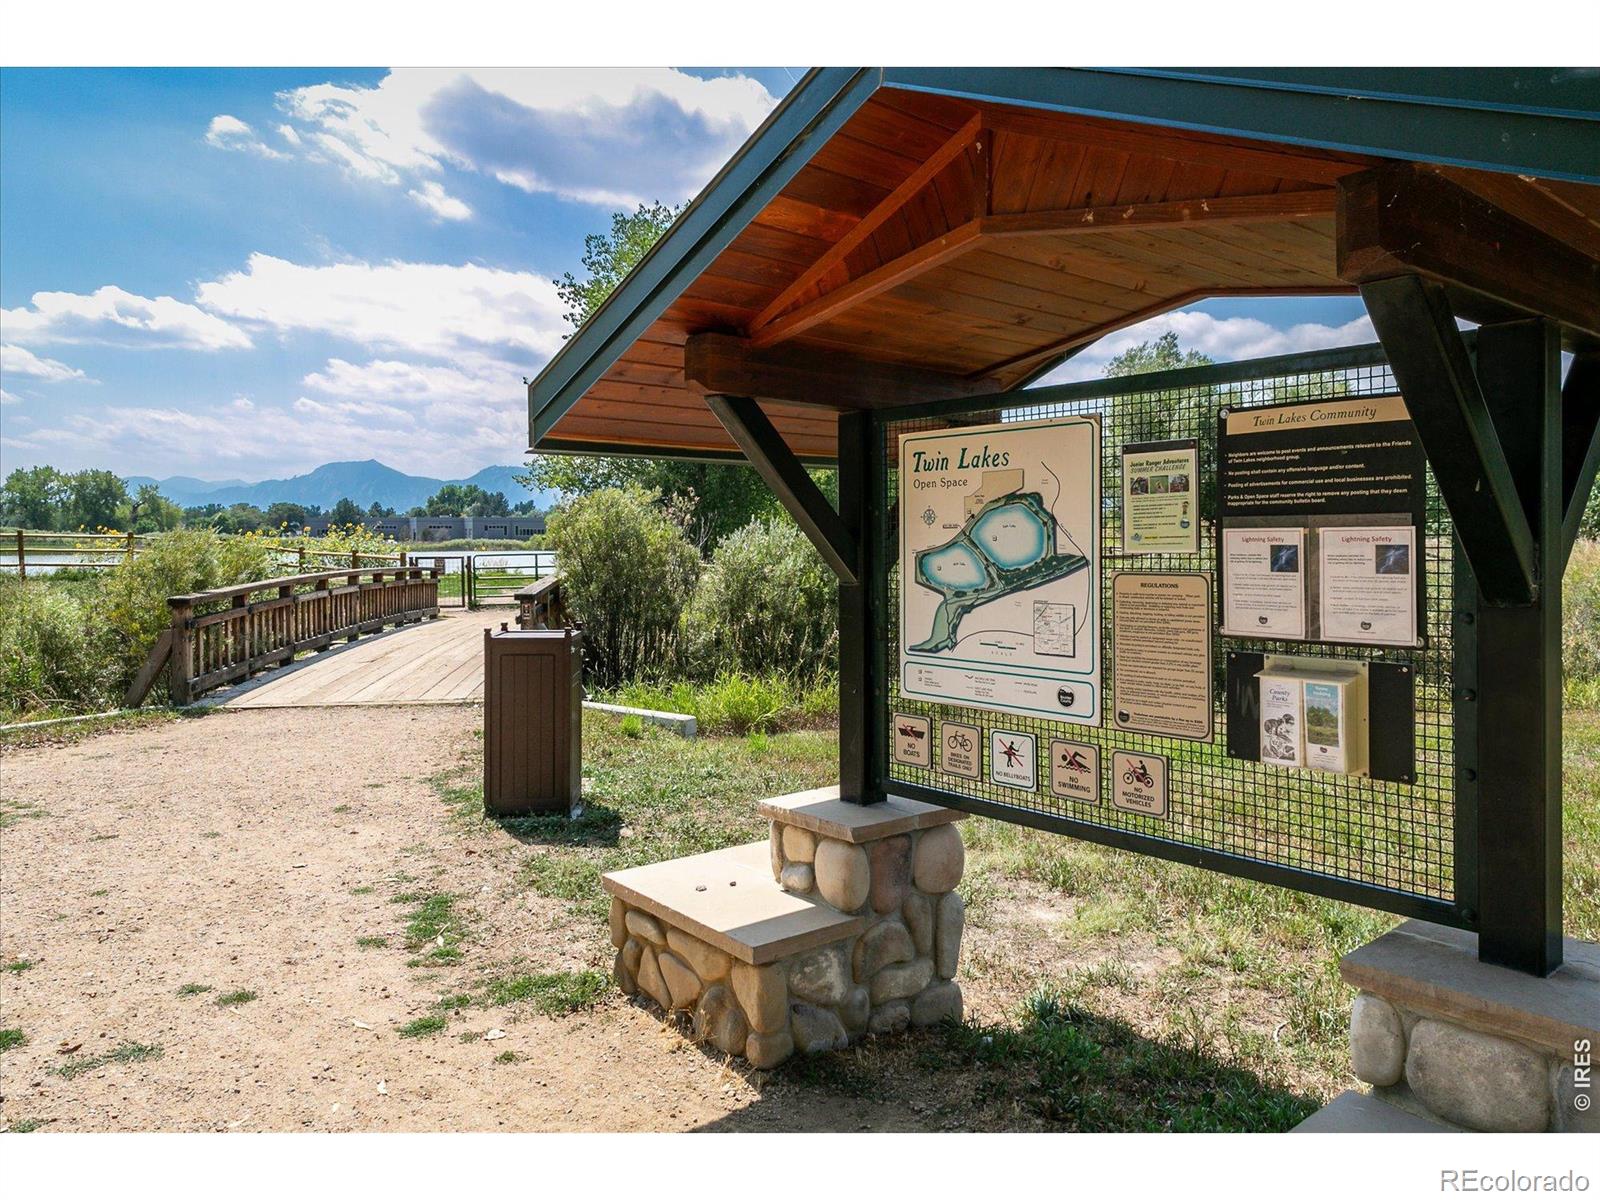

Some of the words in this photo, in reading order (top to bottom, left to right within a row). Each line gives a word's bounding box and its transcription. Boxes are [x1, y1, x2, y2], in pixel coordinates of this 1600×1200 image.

[1253, 416, 1274, 426] Twin
[1278, 413, 1307, 424] Lakes
[1310, 406, 1376, 420] Community
[913, 451, 948, 472] Twin
[958, 445, 1010, 469] Lakes
[1155, 464, 1185, 472] CHALLENGE
[913, 479, 936, 490] Open
[940, 478, 968, 489] Space
[1270, 689, 1290, 697] County
[904, 749, 920, 757] BOATS
[948, 757, 972, 765] DESIGNATED
[1004, 772, 1030, 781] BELLYBOATS
[1058, 782, 1090, 793] SWIMMING
[1122, 792, 1154, 802] MOTORIZED
[1126, 799, 1151, 808] VEHICLES
